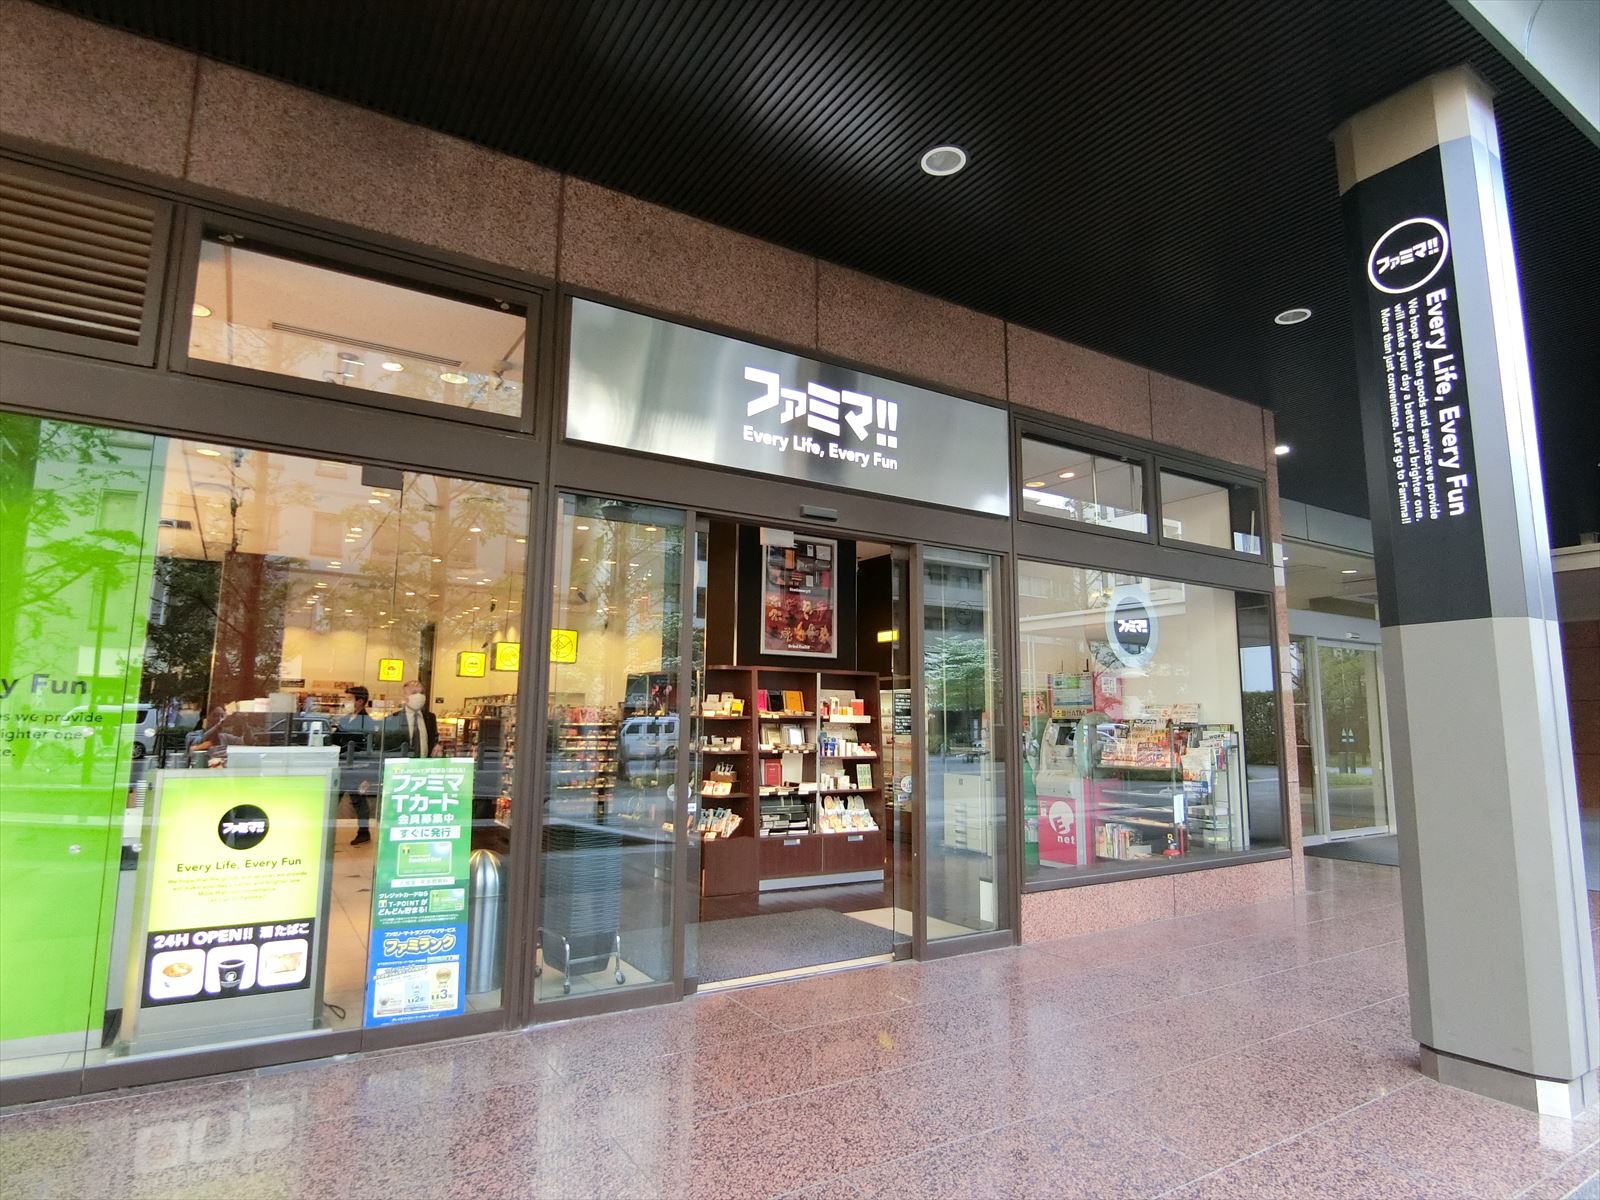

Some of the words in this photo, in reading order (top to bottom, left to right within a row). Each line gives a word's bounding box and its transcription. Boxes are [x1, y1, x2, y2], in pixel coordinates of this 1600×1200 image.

[1376, 236, 1439, 275] ファミマ!!
[1394, 303, 1406, 321] will
[1407, 297, 1418, 315] We
[1380, 307, 1391, 333] More
[1408, 315, 1420, 340] hope
[1425, 288, 1447, 349] Every
[1383, 333, 1393, 354] than
[1396, 322, 1407, 349] make
[1396, 349, 1408, 371] your
[1412, 340, 1423, 361] that
[1382, 354, 1395, 372] just
[1414, 361, 1425, 377] the
[1400, 374, 1412, 391] day
[1433, 354, 1458, 401] Life,
[1387, 372, 1400, 431] convenience.
[1414, 378, 1429, 408] goods
[744, 366, 898, 449] ファミマ!!
[1404, 401, 1415, 433] better
[1419, 409, 1432, 427] and
[743, 425, 789, 452] Every
[793, 435, 825, 458] Life,
[828, 442, 870, 468] Every
[873, 452, 898, 470] Fun
[1393, 431, 1404, 454] Let's
[1407, 435, 1419, 454] and
[1422, 428, 1434, 466] services
[1438, 406, 1460, 469] Every
[1393, 455, 1403, 468] go
[1396, 469, 1406, 480] to
[1408, 455, 1422, 497] brighter
[1425, 466, 1434, 481] we
[1425, 483, 1441, 520] provide
[1446, 474, 1468, 516] Fun
[1414, 499, 1423, 522] one.
[31, 673, 87, 695] Fun
[16, 714, 39, 722] we
[44, 711, 103, 724] provide
[391, 774, 464, 793] ファミマ
[391, 793, 459, 813] Tカード
[398, 813, 454, 824] 会員募集中
[400, 827, 451, 838] すぐに発行
[1057, 835, 1075, 845] net
[177, 863, 212, 873] Every
[245, 859, 277, 869] Every
[281, 857, 302, 866] Fun
[378, 906, 428, 916] どんどん貯まる!
[153, 932, 190, 949] 24H
[192, 927, 254, 945] OPEN!!
[384, 934, 456, 957] ファミランク
